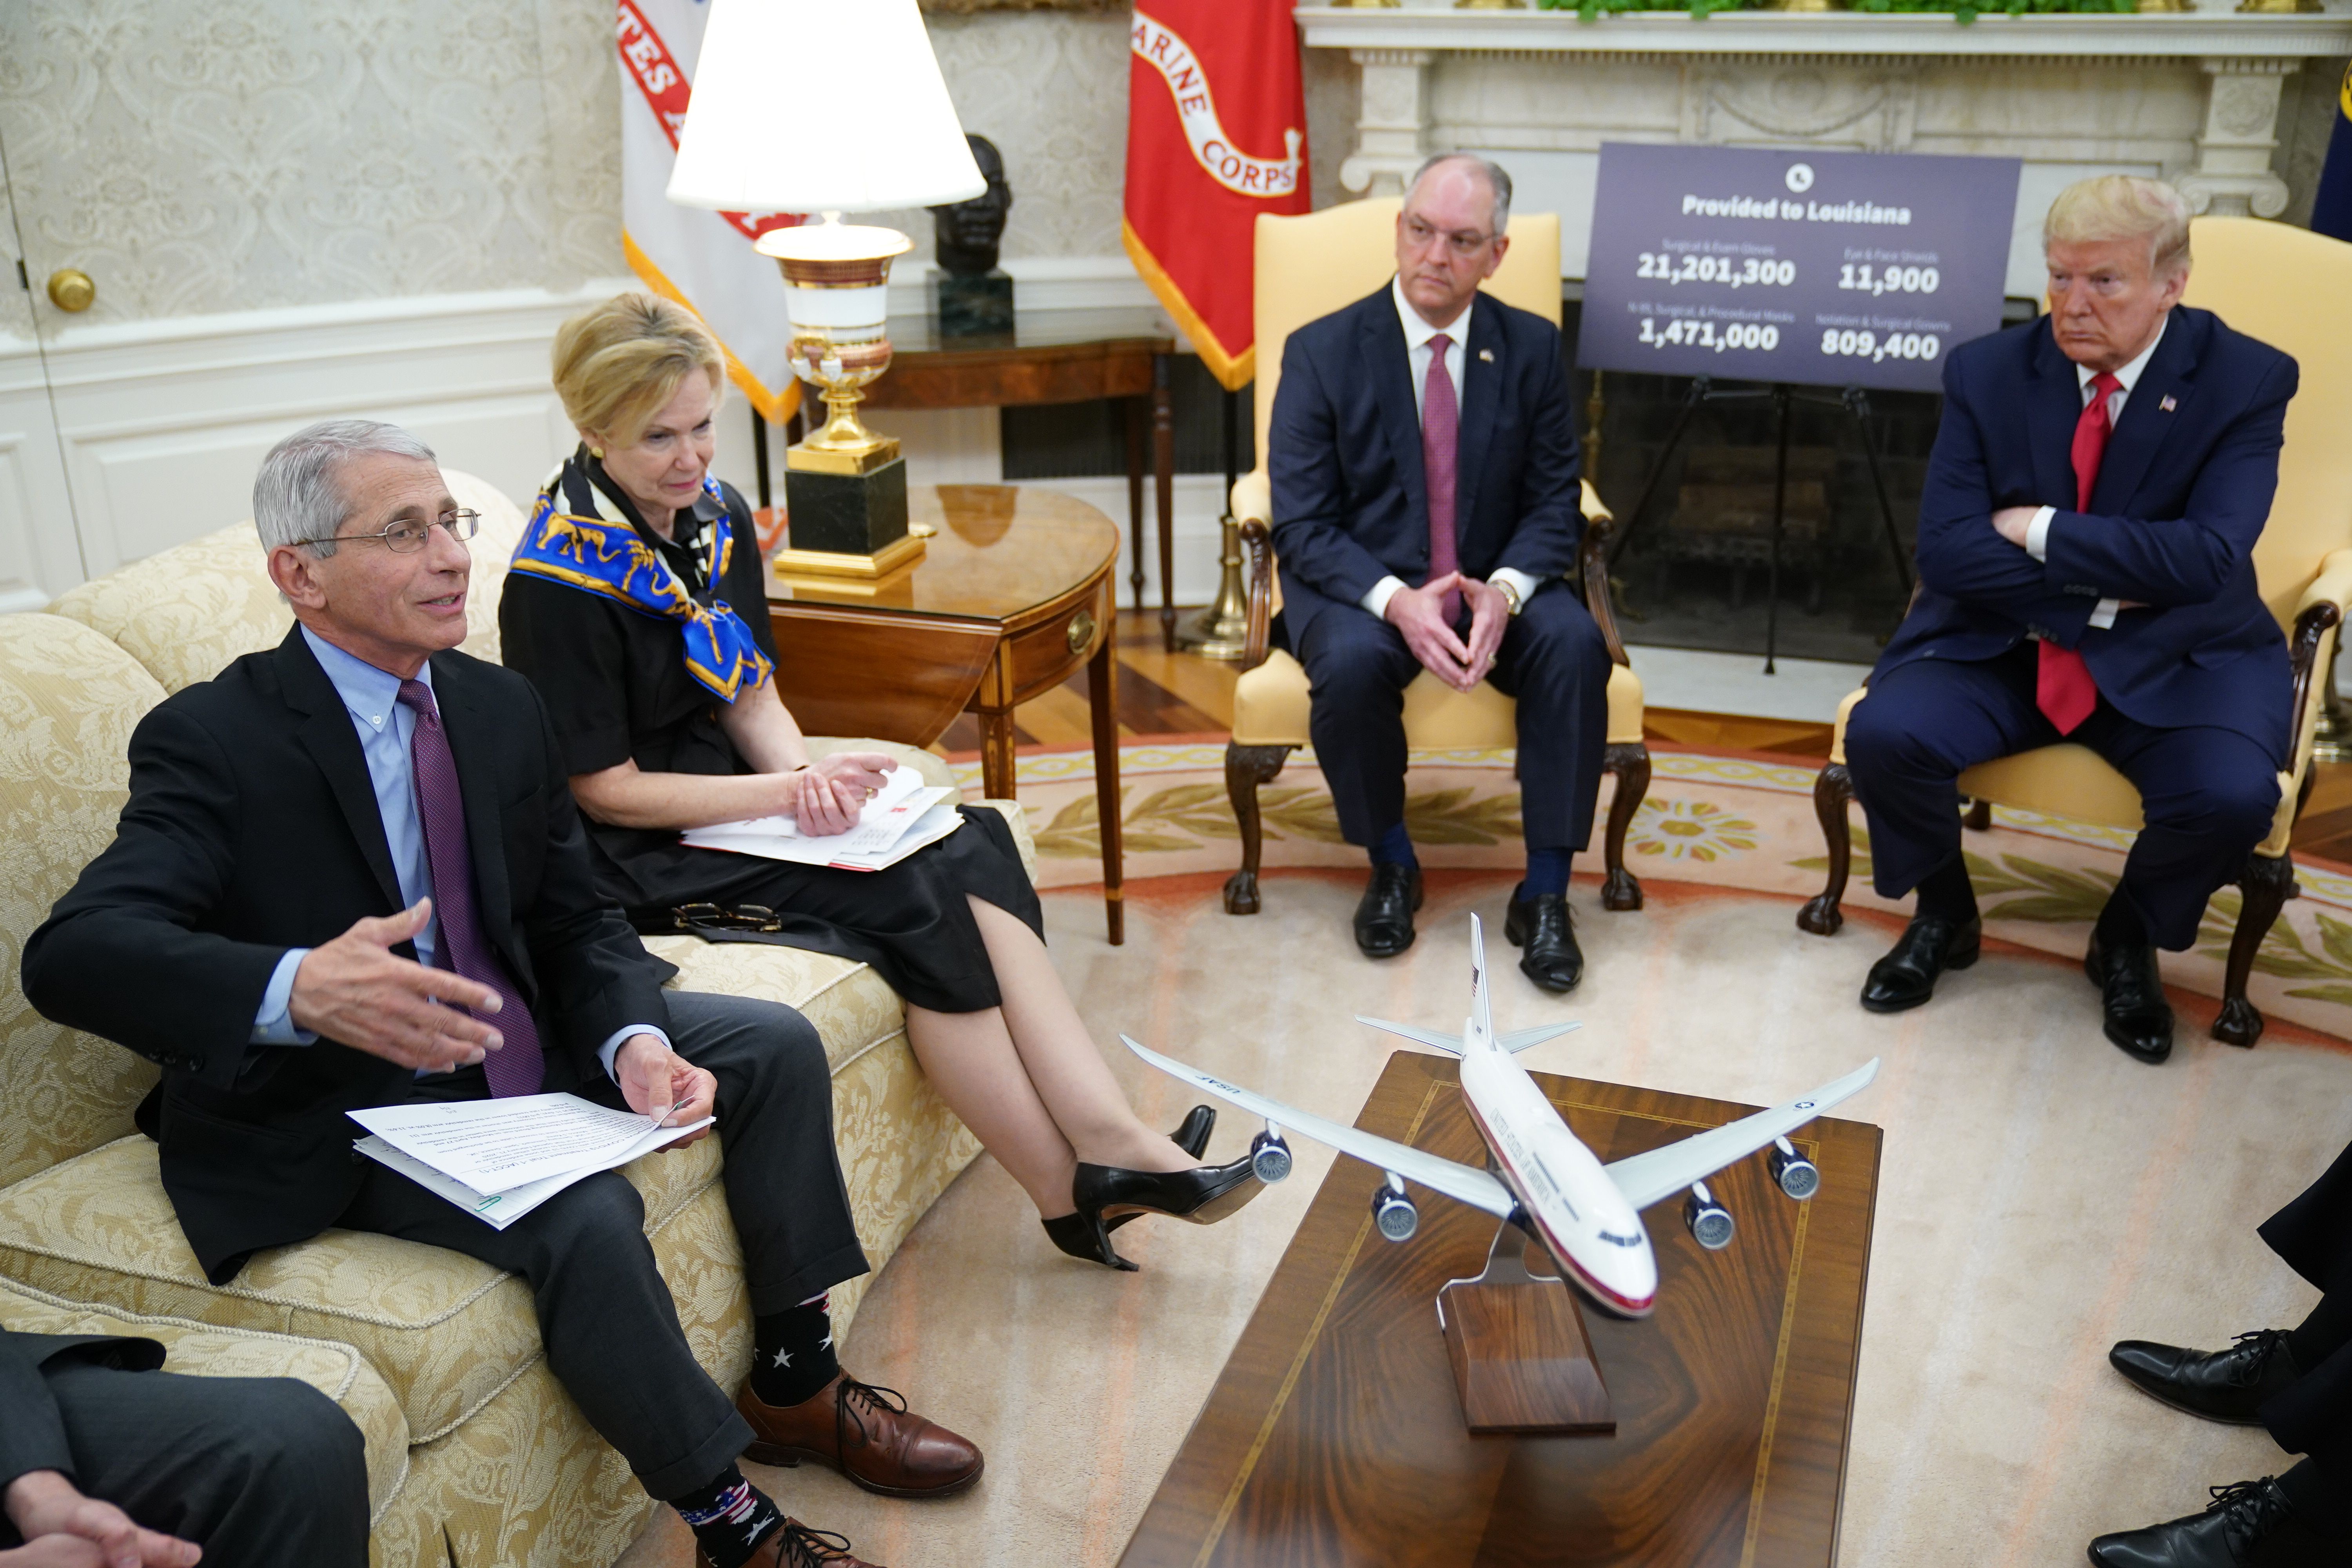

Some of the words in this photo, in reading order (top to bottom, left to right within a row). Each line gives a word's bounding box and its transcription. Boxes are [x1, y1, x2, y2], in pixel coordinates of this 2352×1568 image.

[617, 4, 678, 95] TES
[1132, 24, 1207, 116] ARINE
[1203, 140, 1293, 191] CORPS
[1682, 194, 1779, 219] Provided
[1780, 199, 1804, 220] to
[1806, 200, 1912, 226] Louisiana
[1636, 252, 1797, 289] 21,201,300
[1838, 263, 1940, 297] 11,900
[1638, 317, 1780, 353] 1,471,000
[1820, 328, 1940, 364] 809,400
[1195, 1075, 1240, 1094] USAF
[479, 1162, 518, 1172] (ACCT-1)
[1490, 1107, 1508, 1136] UNITED
[1526, 1166, 1550, 1205] AMERICA
